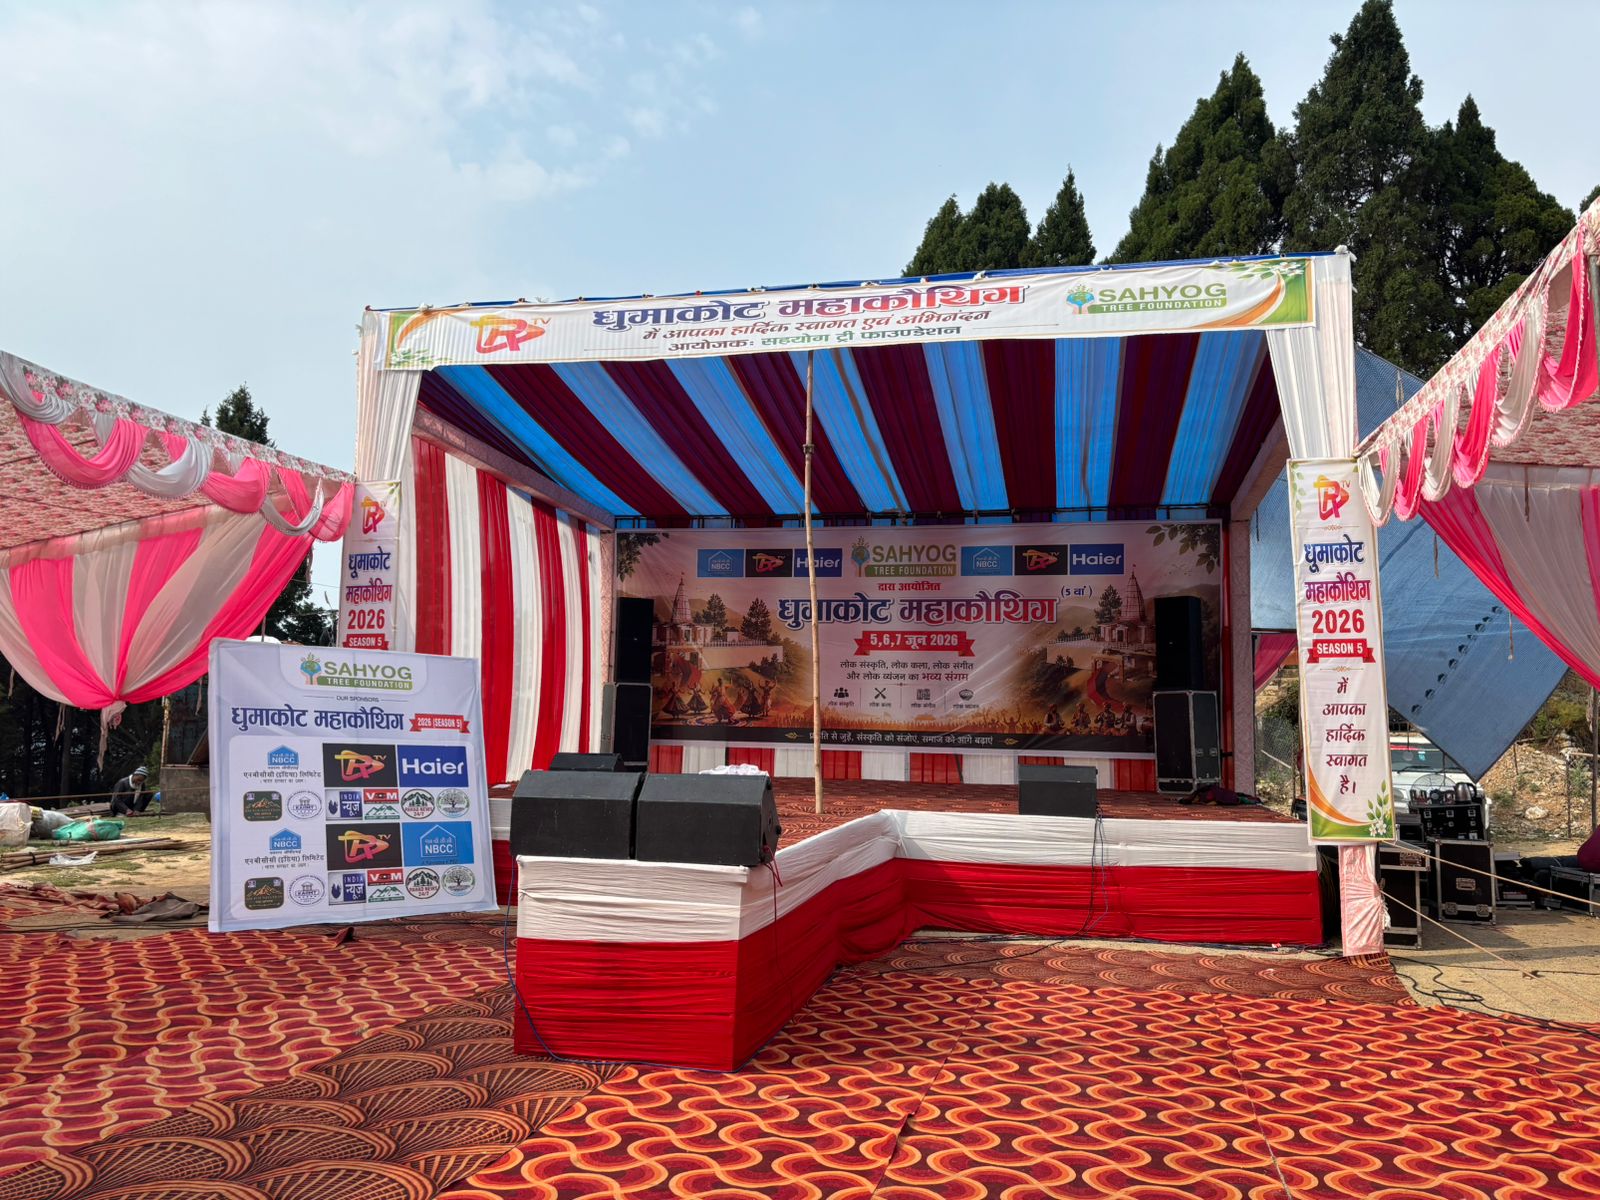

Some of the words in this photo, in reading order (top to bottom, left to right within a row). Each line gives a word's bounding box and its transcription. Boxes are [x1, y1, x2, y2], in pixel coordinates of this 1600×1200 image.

[1098, 283, 1227, 302] SAHYOG
[779, 285, 1026, 318] महाकौथिग
[1102, 302, 1137, 312] TREE
[1139, 298, 1222, 311] FOUNDATION
[643, 328, 661, 340] में
[663, 327, 727, 339] आपका
[731, 321, 790, 336] हार्दिक
[795, 317, 857, 331] स्वागत
[861, 314, 894, 331] एवं
[896, 310, 992, 325] अभिनंदन
[761, 333, 831, 346] सहयोग
[836, 330, 855, 343] ट्री
[861, 325, 962, 340] फाउण्डेशन
[872, 545, 957, 563] SAHYOG
[1072, 552, 1122, 566] Haier
[1304, 534, 1365, 574] धूमाकोट
[348, 546, 392, 579] धूमाकोट
[874, 566, 896, 576] TREE
[898, 565, 954, 576] FOUNDATION
[976, 560, 998, 568] NBCC
[346, 578, 393, 605] महाकौथिग
[898, 581, 942, 591] आयोजित
[1304, 572, 1371, 603] महाकौथिग
[899, 590, 1059, 624] महाकौथिग
[347, 609, 385, 630] 2026
[1312, 609, 1365, 634] 2026
[349, 634, 376, 647] SEASON
[377, 636, 383, 647] 5
[870, 634, 901, 648] 5,6,7
[904, 634, 928, 650] जून
[930, 634, 959, 647] 2026
[1317, 643, 1353, 655] SEASON
[1357, 642, 1364, 654] 5
[324, 661, 412, 680] SAHYOG
[840, 659, 857, 669] लोक
[890, 660, 908, 669] लोक
[932, 660, 950, 669] लोक
[327, 677, 351, 686] TREE
[354, 678, 410, 690] FOUNDATION
[847, 670, 861, 680] और
[863, 671, 880, 680] लोक
[908, 672, 919, 681] का
[921, 672, 942, 681] भव्य
[944, 671, 969, 682] संगम
[1337, 676, 1349, 694] में
[1322, 703, 1367, 716] आपका
[231, 704, 308, 732] धुमाकोट
[314, 706, 404, 731] महाकौथिग
[1325, 723, 1366, 743] हार्दिक
[271, 756, 296, 764] NBCC
[402, 758, 464, 775] Haier
[1326, 754, 1368, 768] स्वागत
[341, 793, 360, 801] INDIA
[273, 840, 298, 848] NBCC
[424, 844, 453, 854] NBCC
[344, 876, 363, 884] INDIA
